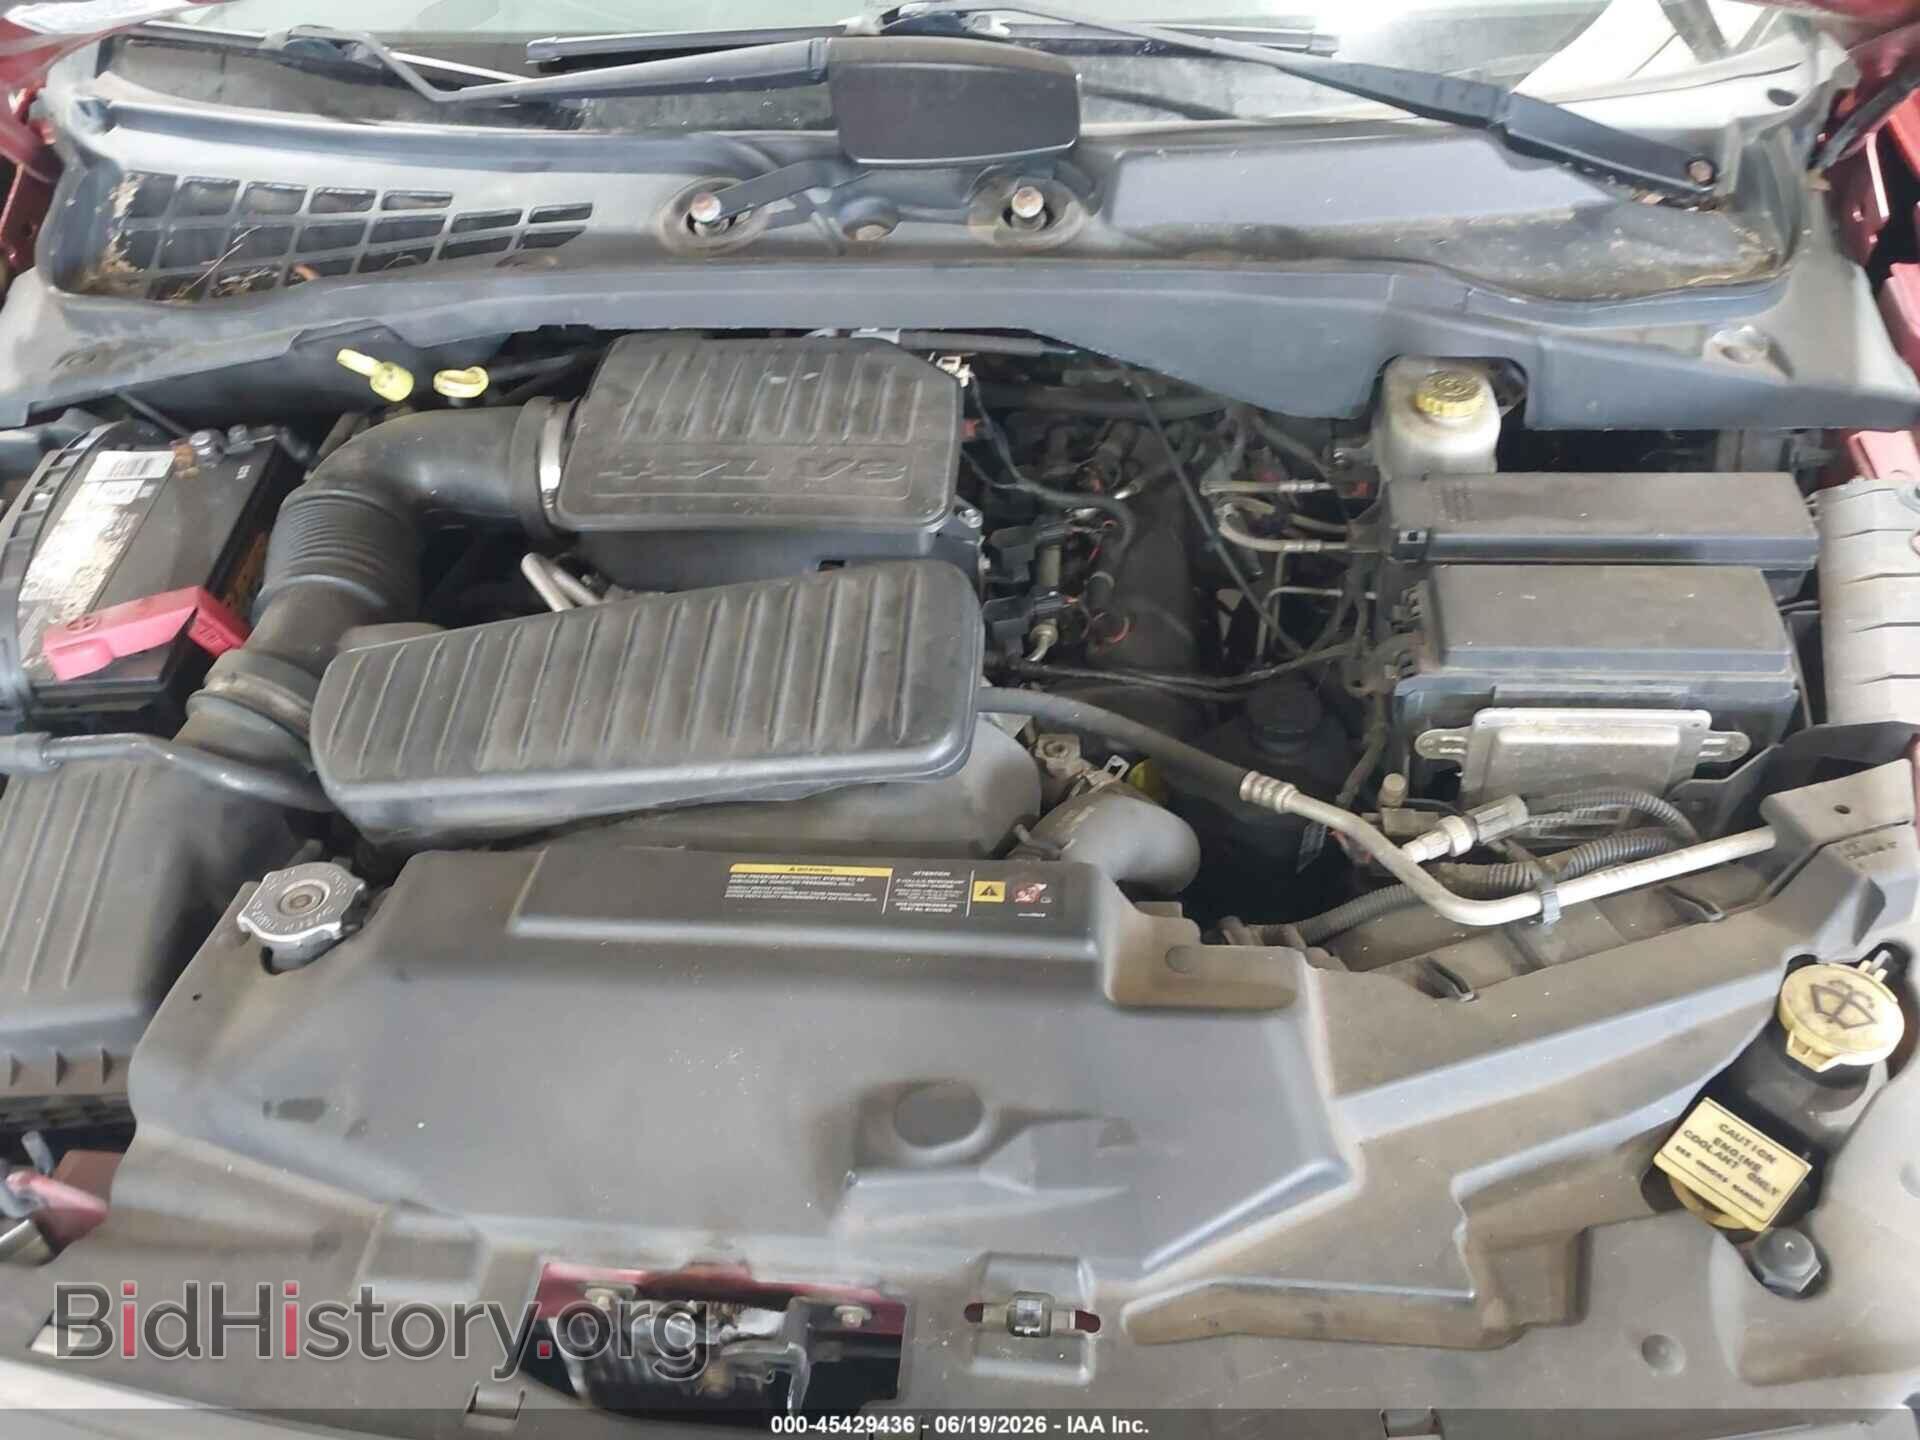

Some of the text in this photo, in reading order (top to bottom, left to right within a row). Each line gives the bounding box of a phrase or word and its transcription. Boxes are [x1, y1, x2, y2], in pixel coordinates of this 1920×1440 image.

[1683, 1129, 1780, 1196] COOLANT ONLY
[1712, 1137, 1762, 1173] ENGINE
[1718, 1123, 1777, 1164] CAUTION
